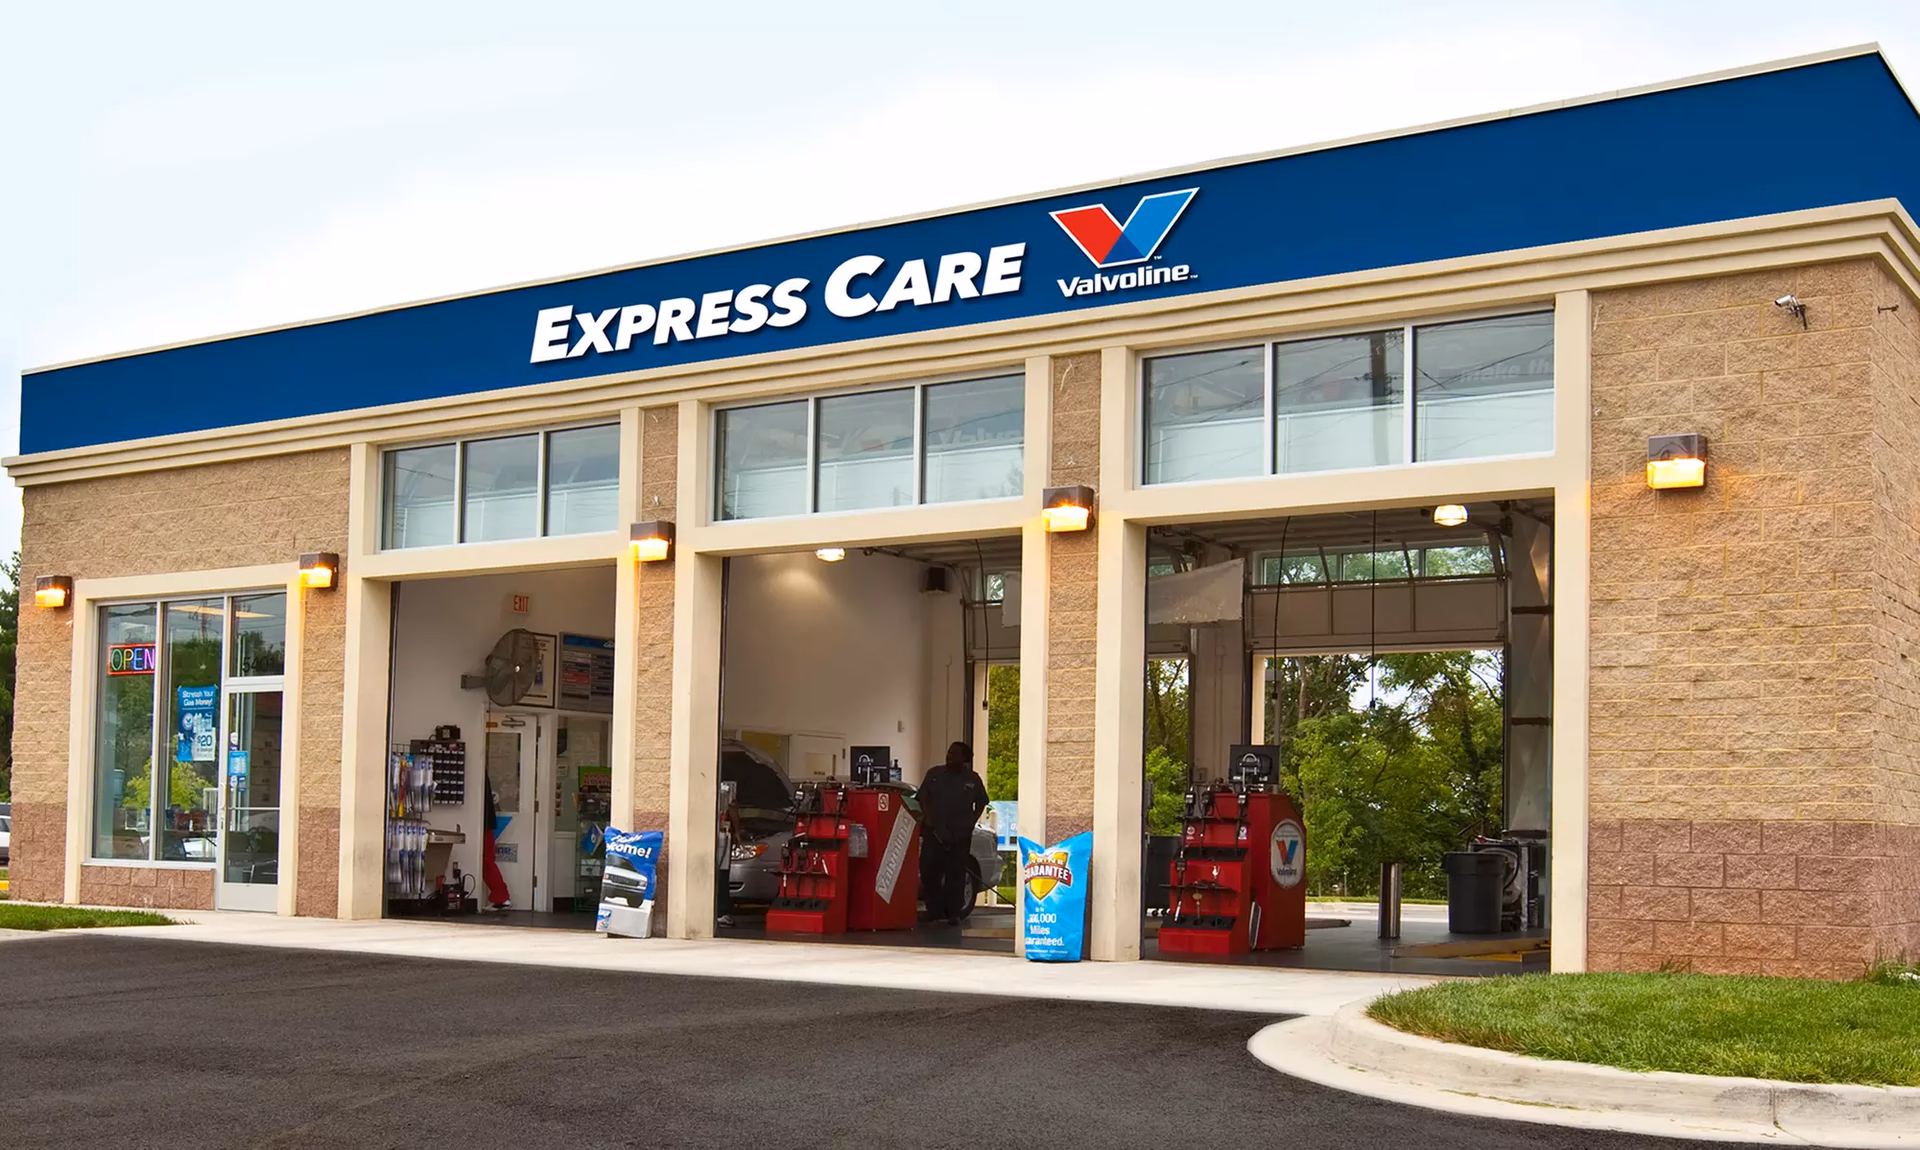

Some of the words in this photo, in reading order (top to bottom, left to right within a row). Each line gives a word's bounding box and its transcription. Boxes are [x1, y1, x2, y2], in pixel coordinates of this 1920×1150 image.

[1056, 264, 1190, 298] Valvoline
[530, 277, 811, 364] EXPRESS
[824, 242, 1027, 318] CARE
[112, 647, 155, 670] OPEN
[183, 698, 195, 706] Gas
[197, 734, 213, 747] $20
